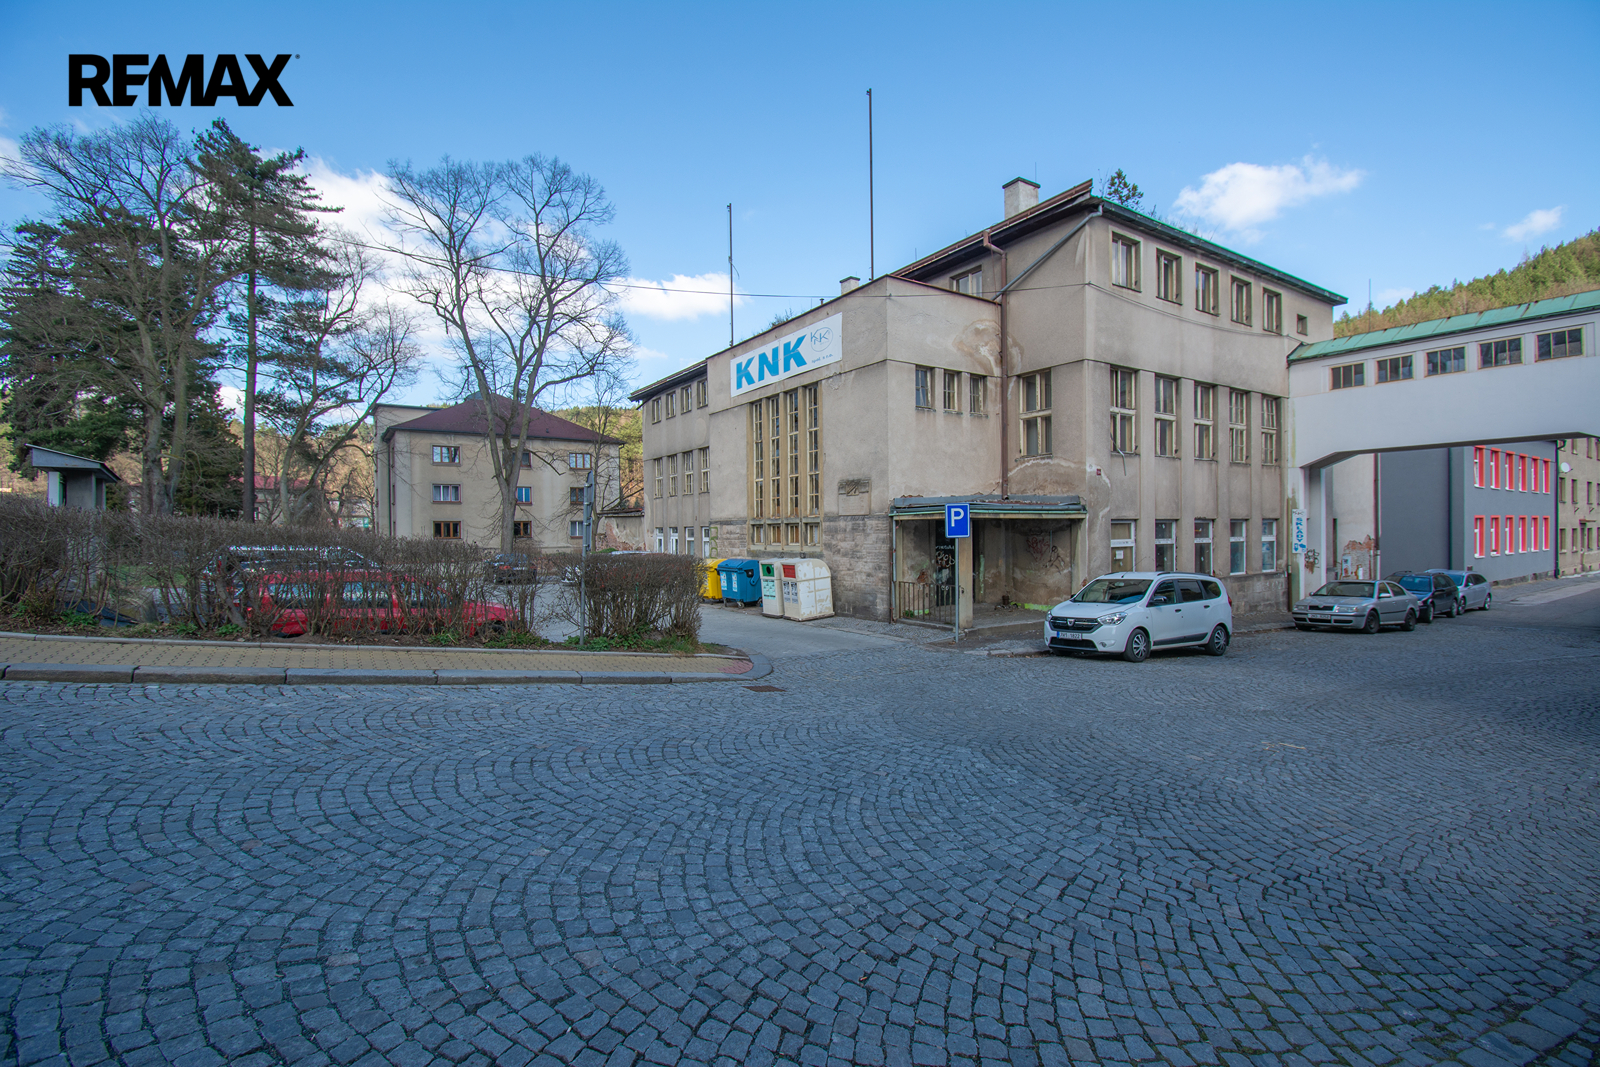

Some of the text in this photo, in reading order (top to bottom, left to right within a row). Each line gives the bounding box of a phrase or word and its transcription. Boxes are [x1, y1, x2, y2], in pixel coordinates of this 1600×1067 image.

[736, 334, 807, 390] KNK
[951, 508, 964, 527] P
[1295, 517, 1304, 542] SKLADY
